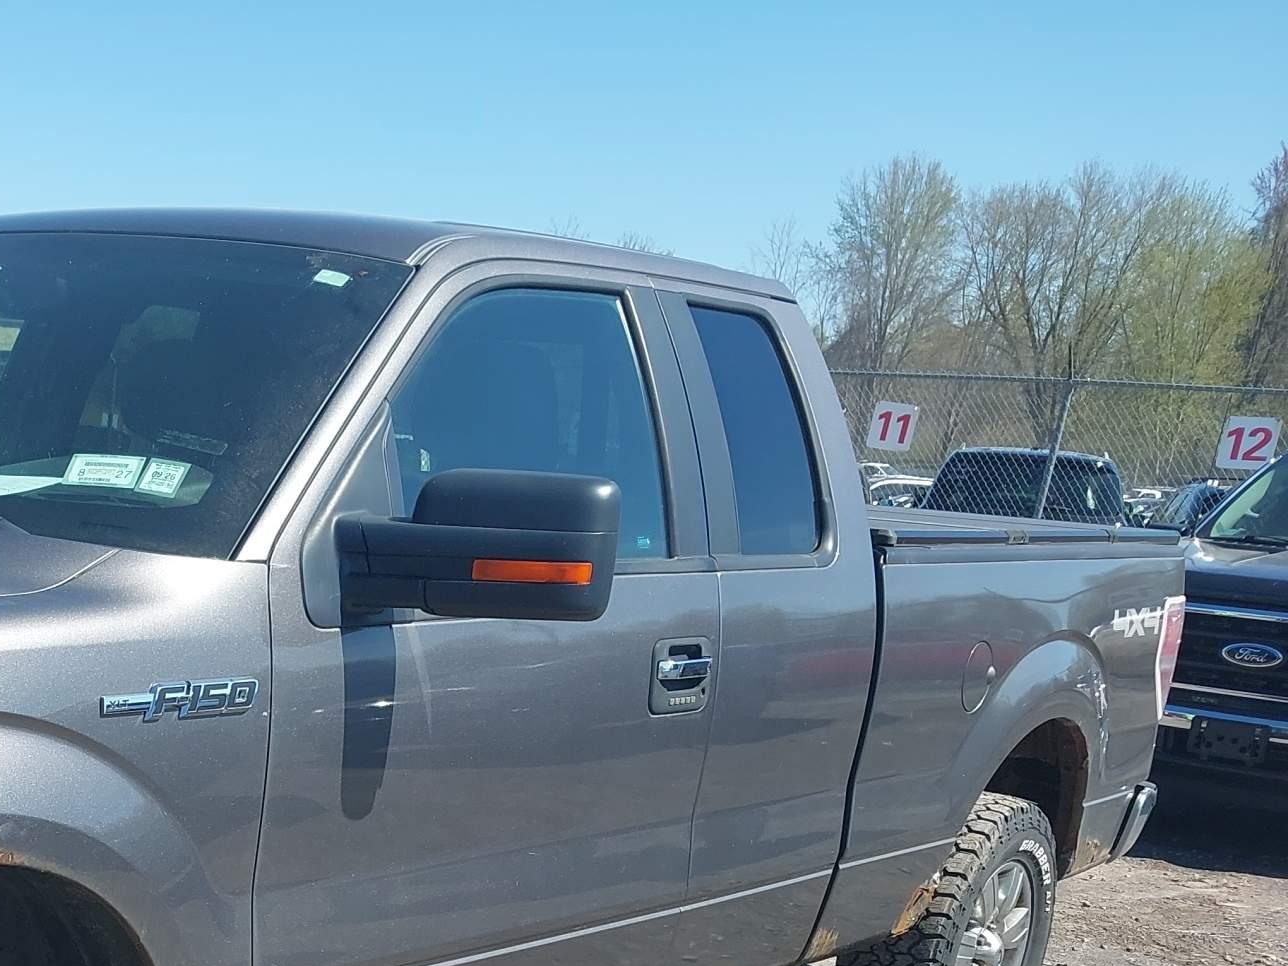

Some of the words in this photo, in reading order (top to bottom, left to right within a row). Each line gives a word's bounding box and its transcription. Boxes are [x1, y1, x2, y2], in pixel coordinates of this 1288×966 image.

[878, 410, 912, 444] 11
[1227, 426, 1273, 461] 12
[1233, 645, 1268, 664] Ford
[1019, 840, 1051, 886] GRABBER
